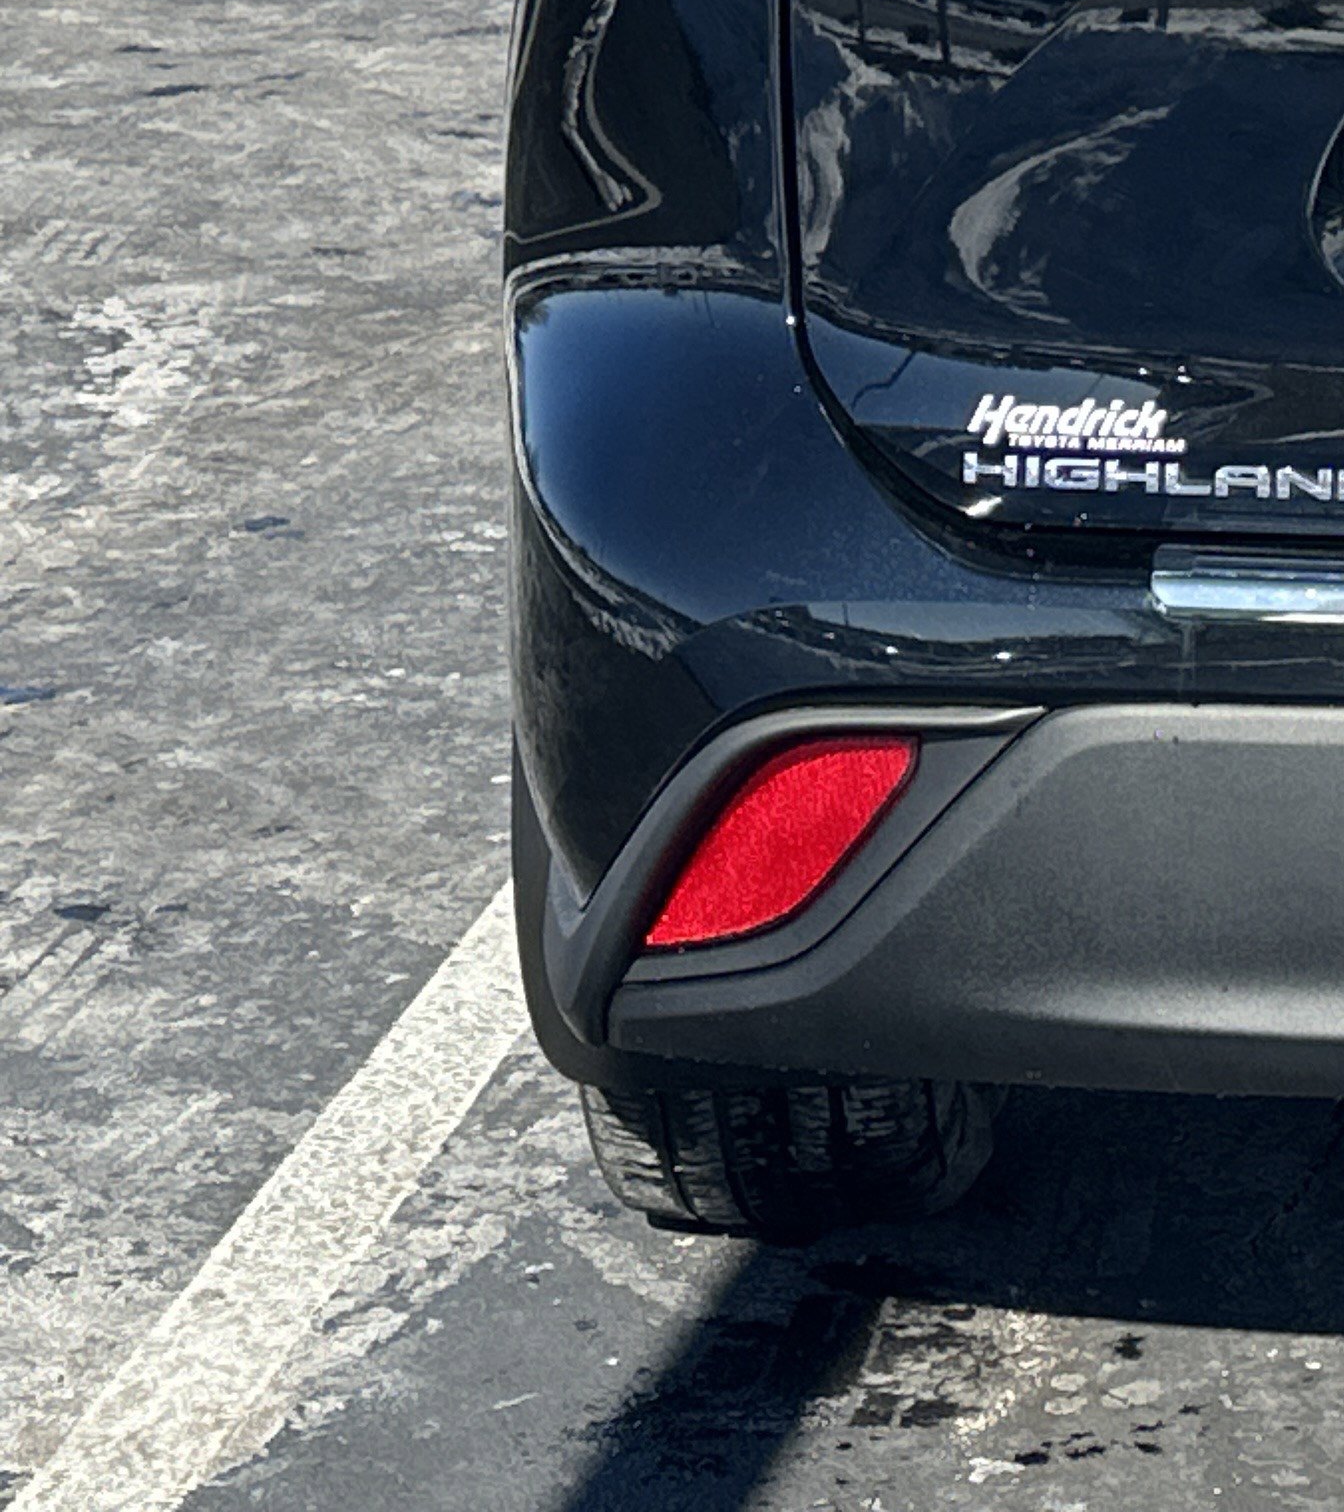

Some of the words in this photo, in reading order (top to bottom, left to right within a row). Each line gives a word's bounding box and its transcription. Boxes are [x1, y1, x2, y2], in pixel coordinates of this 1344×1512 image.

[967, 394, 1168, 445] Hendrick
[1008, 434, 1080, 448] TOYOTA
[1087, 438, 1187, 453] MERRIAM
